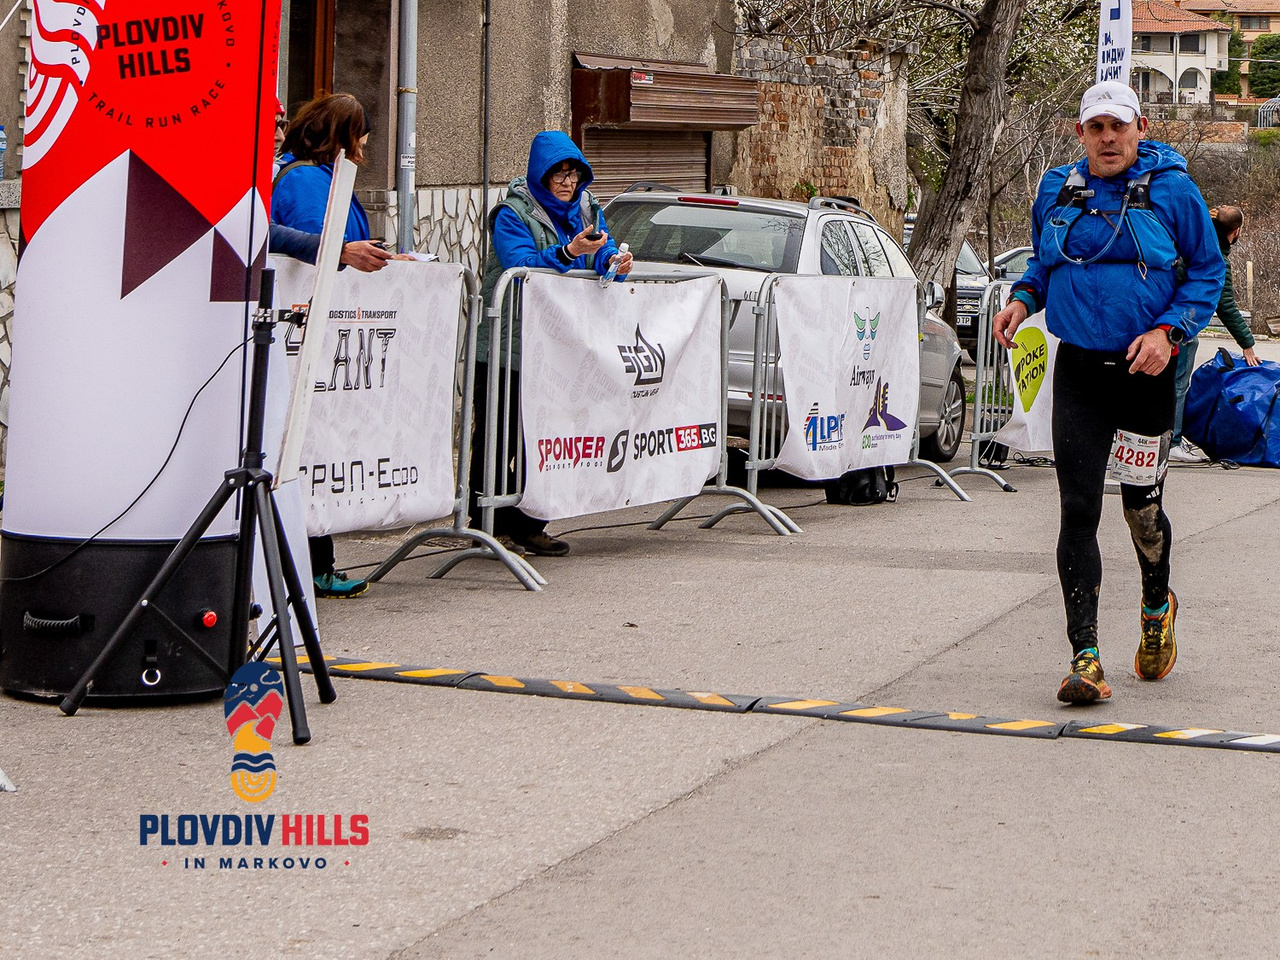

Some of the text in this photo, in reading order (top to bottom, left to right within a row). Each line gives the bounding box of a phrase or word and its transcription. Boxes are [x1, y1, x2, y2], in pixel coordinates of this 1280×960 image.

[96, 13, 205, 50] PLOVDIV
[118, 47, 191, 80] HILLS
[87, 79, 225, 128] TRAIL RUN RACE
[361, 311, 397, 319] TRANSPORT
[1020, 343, 1045, 371] POKE
[538, 436, 605, 473] SPONSER
[633, 429, 673, 460] SPORT
[1114, 445, 1156, 468] 4282
